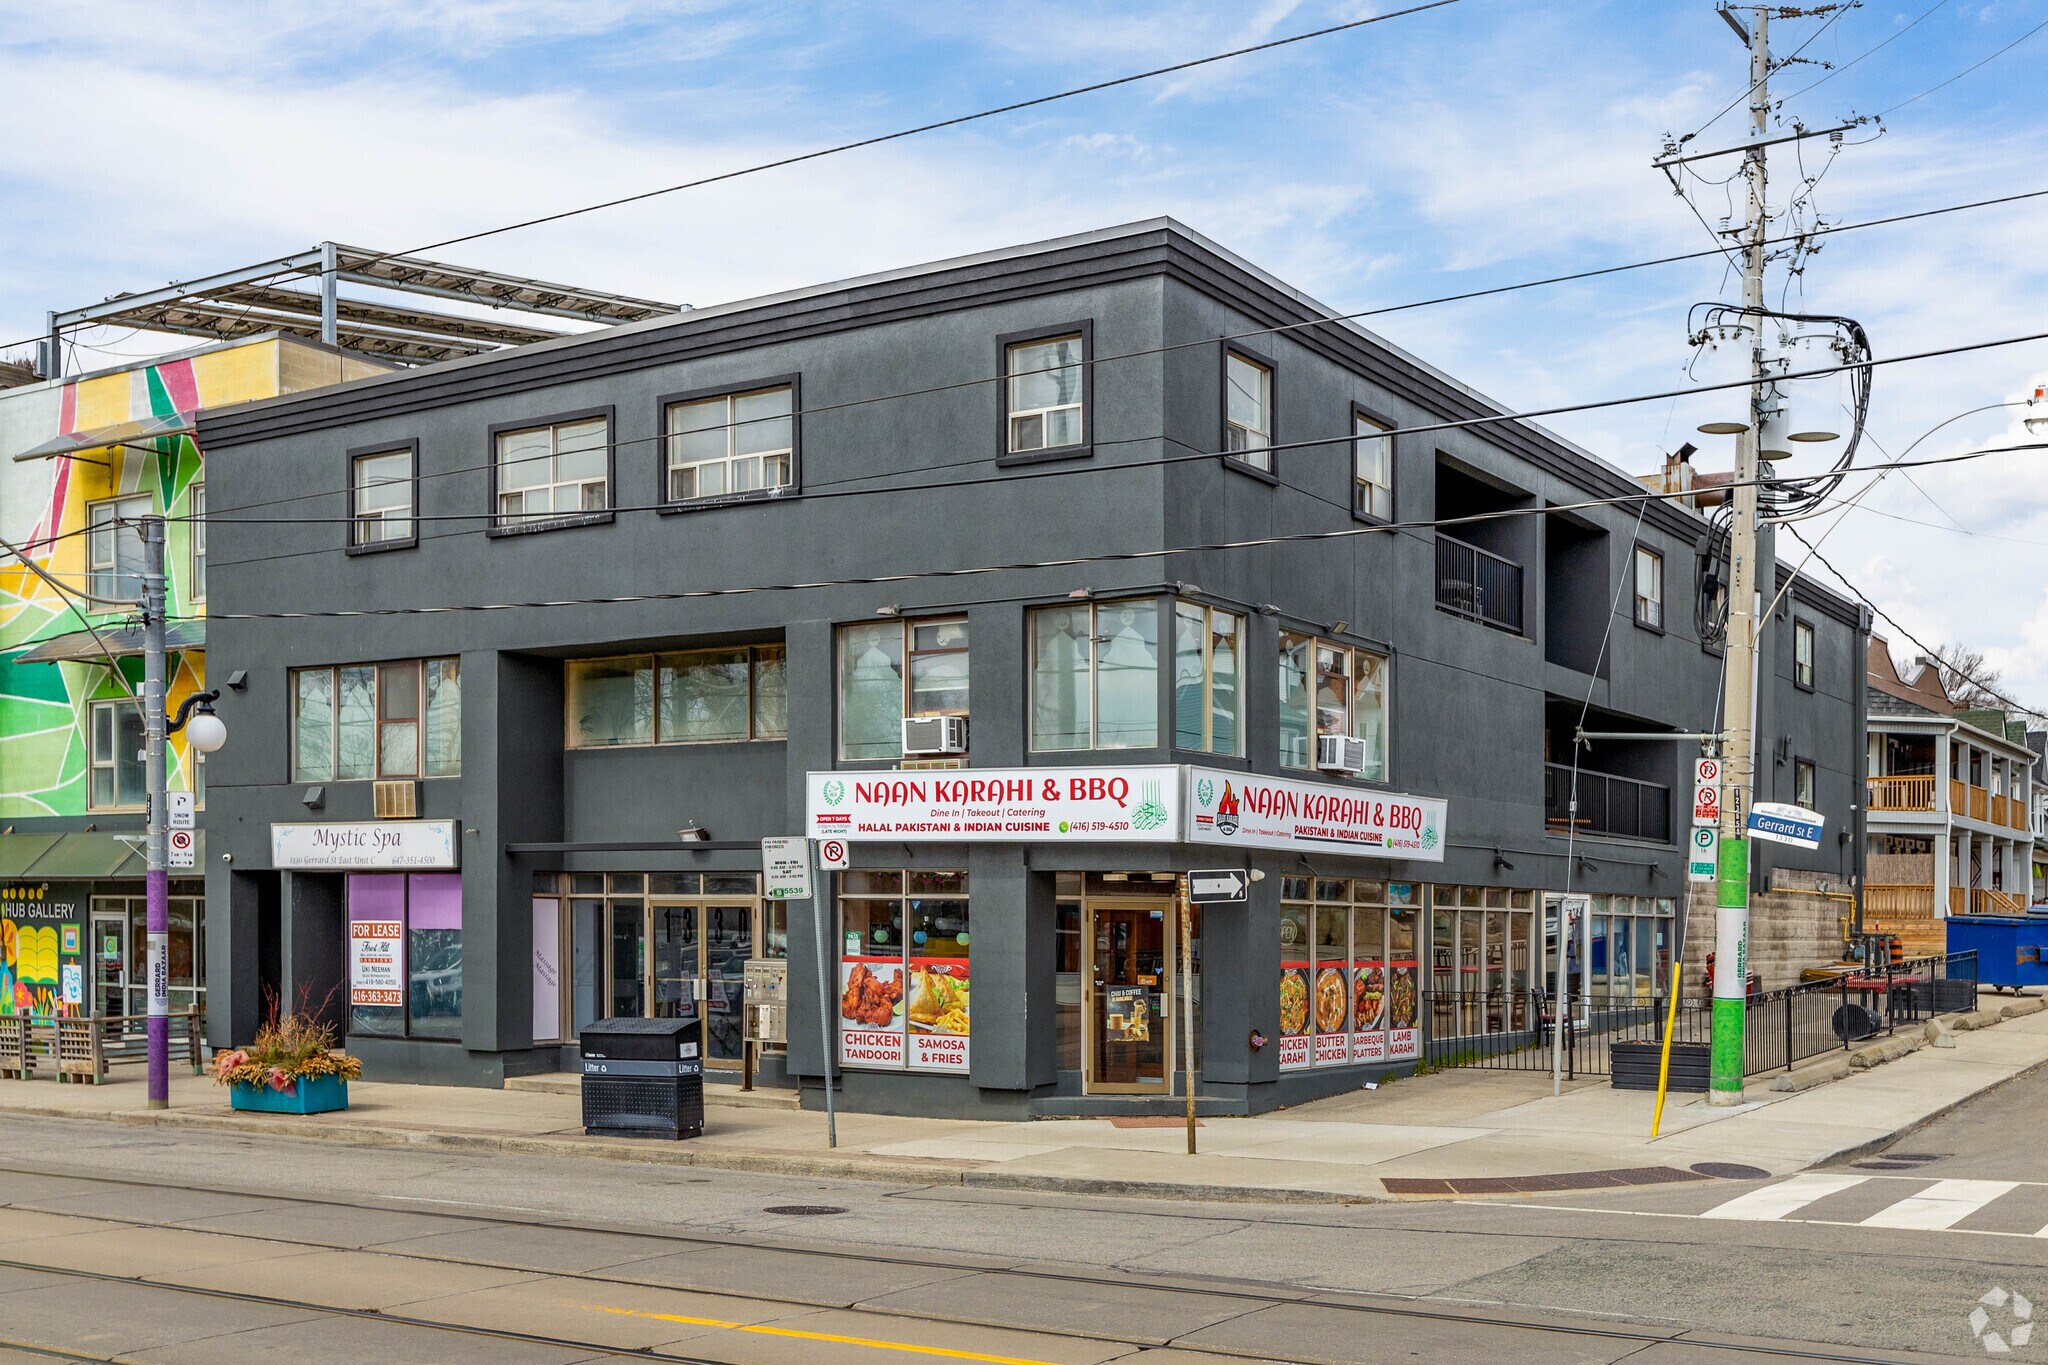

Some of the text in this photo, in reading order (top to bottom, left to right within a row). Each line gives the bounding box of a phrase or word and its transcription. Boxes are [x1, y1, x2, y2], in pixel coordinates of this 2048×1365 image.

[855, 781, 926, 807] NAAN
[935, 779, 1032, 806] KARAHI
[1042, 778, 1060, 801] &
[1070, 777, 1128, 809] BBQ
[967, 808, 999, 817] Takeout
[1007, 808, 1046, 818] Catering
[1243, 786, 1299, 821] NAAN
[1303, 793, 1369, 828] KARAHI
[1373, 802, 1385, 828] &
[1389, 804, 1422, 839] BBQ
[858, 822, 1050, 832] HALAL PAKISTANI & INDIAN CUISINE
[1069, 821, 1129, 832] (416) 519-4510
[1757, 817, 1796, 834] Gerrard
[1806, 827, 1814, 838] E
[312, 827, 402, 854] Mystic Spa
[1294, 825, 1383, 843] PAKISTANI & INDIAN CUISINE
[1775, 834, 1794, 844] 1330
[304, 855, 331, 864] Gerrard
[331, 855, 338, 864] St
[340, 855, 353, 864] East
[354, 855, 370, 864] Unit
[371, 856, 376, 864] C
[391, 856, 436, 865] 647-351-4500
[5, 902, 76, 919] HUB GALLERY
[353, 924, 400, 938] FOR LEASE
[371, 965, 391, 973] NEEMAN
[353, 990, 401, 1003] 416-363-3473
[1111, 990, 1121, 998] CHAI
[1125, 988, 1142, 997] COFFEE
[845, 1033, 901, 1047] CHICKEN
[1316, 1035, 1345, 1048] BUTTER
[1392, 1030, 1412, 1042] LAMB
[918, 1038, 966, 1051] SAMOSA
[1279, 1038, 1308, 1051] HICKEN
[1390, 1042, 1415, 1055] KARAHI
[845, 1048, 901, 1061] TANDOORI
[921, 1052, 963, 1064] & FRIES
[1280, 1051, 1306, 1065] ARAHI
[584, 1062, 600, 1072] Litter
[678, 1063, 692, 1074] Litter
